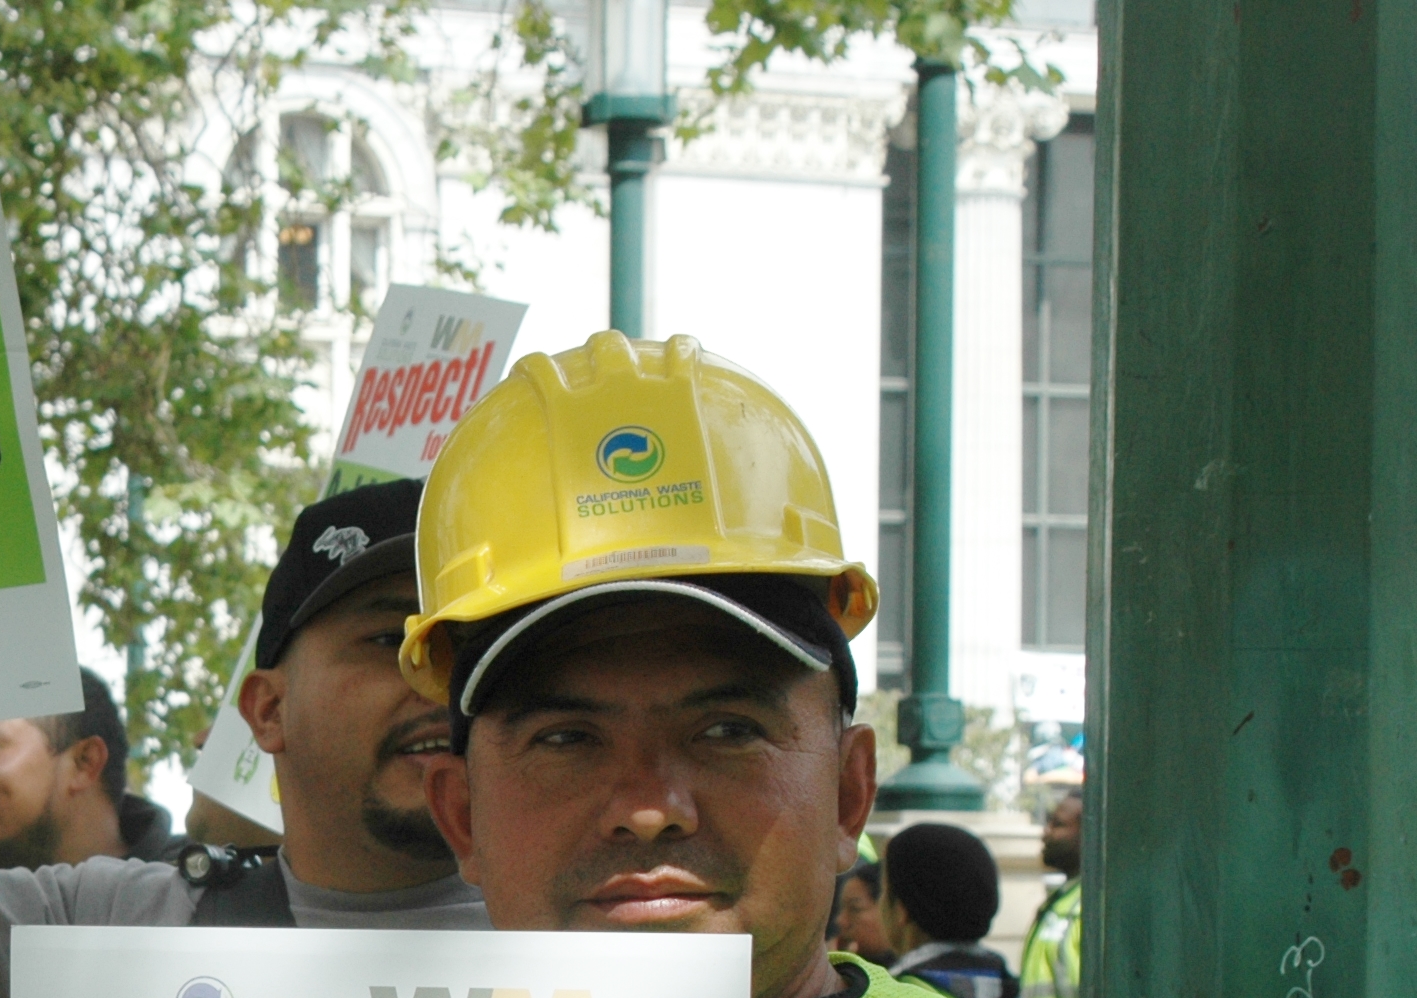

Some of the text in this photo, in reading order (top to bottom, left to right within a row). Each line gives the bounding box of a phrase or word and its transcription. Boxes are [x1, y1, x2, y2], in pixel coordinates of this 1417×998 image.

[341, 339, 496, 454] Respect!
[576, 480, 702, 505] CALIFORNIA WASTE
[577, 490, 705, 518] SOLUTIONS
